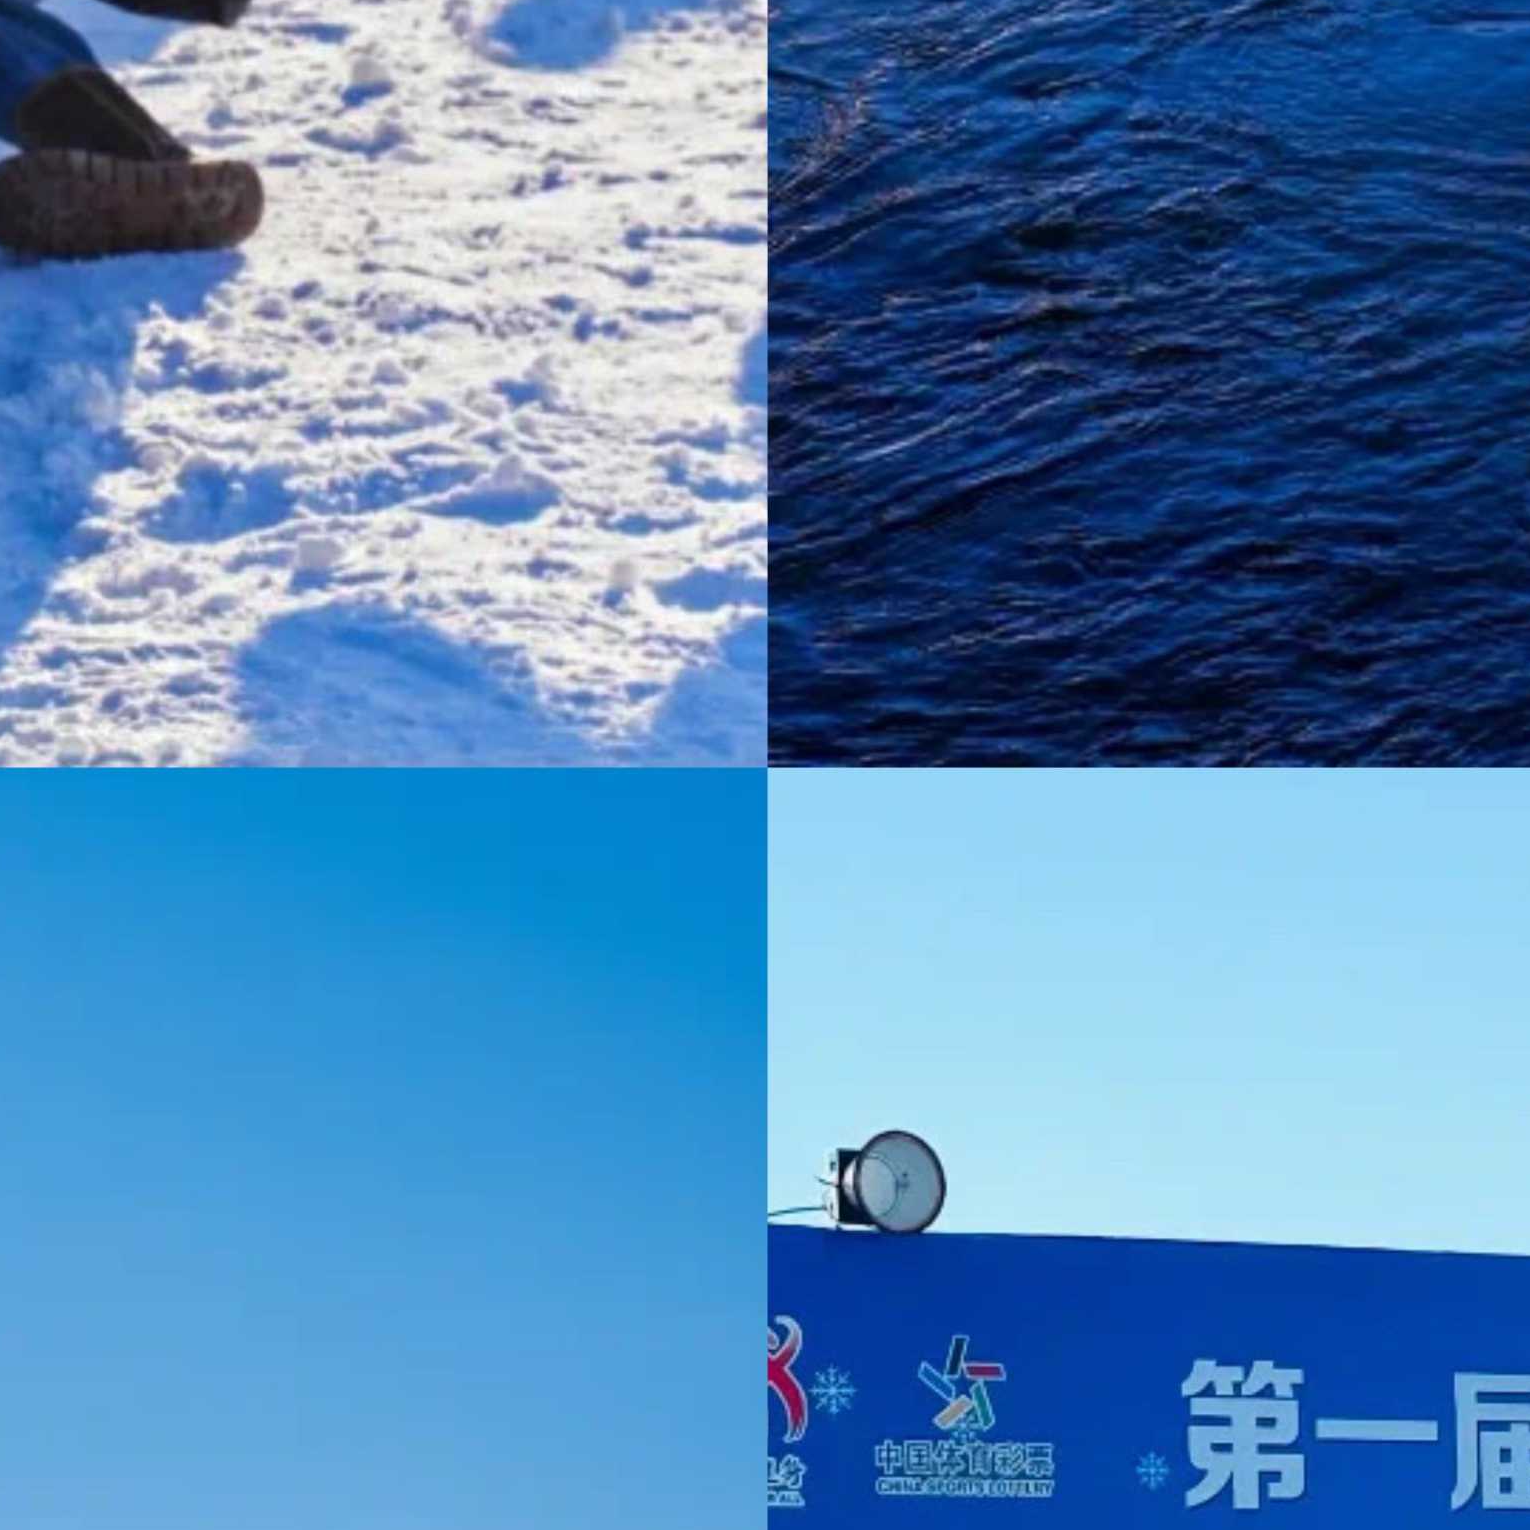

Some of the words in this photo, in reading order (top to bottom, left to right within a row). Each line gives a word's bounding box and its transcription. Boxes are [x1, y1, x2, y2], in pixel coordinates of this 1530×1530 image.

[875, 1439, 1055, 1477] 中国体育彩票
